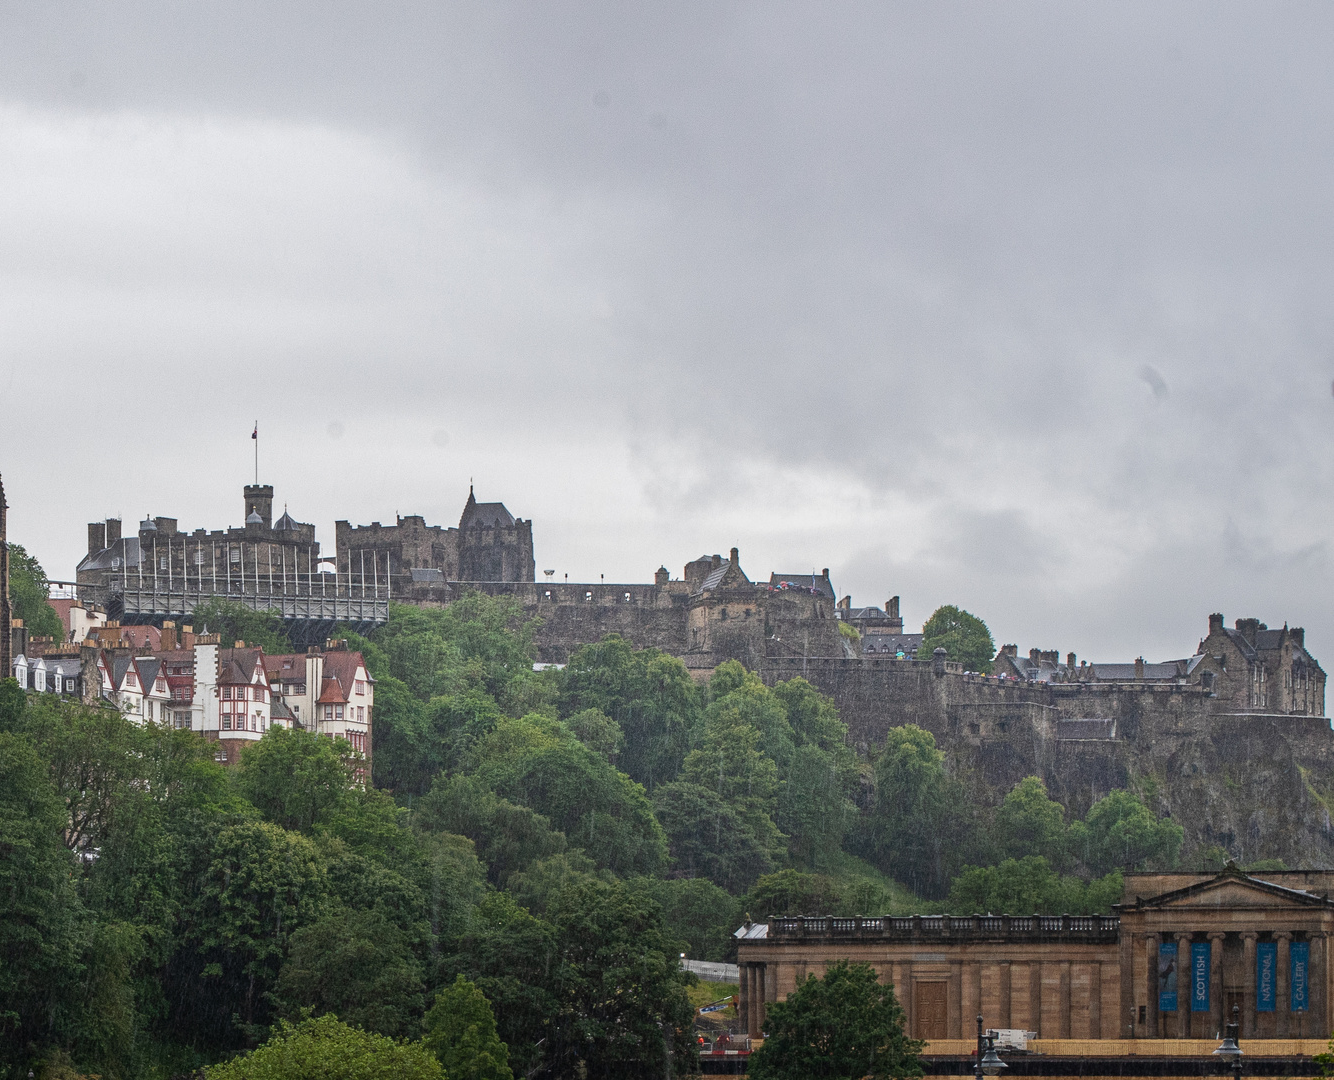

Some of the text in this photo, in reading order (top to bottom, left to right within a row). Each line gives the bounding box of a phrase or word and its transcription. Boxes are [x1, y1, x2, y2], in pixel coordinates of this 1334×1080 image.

[1196, 955, 1206, 1001] SCOTTISH
[1262, 953, 1272, 1002] NATIONAL
[1295, 961, 1305, 1001] GALLERY
